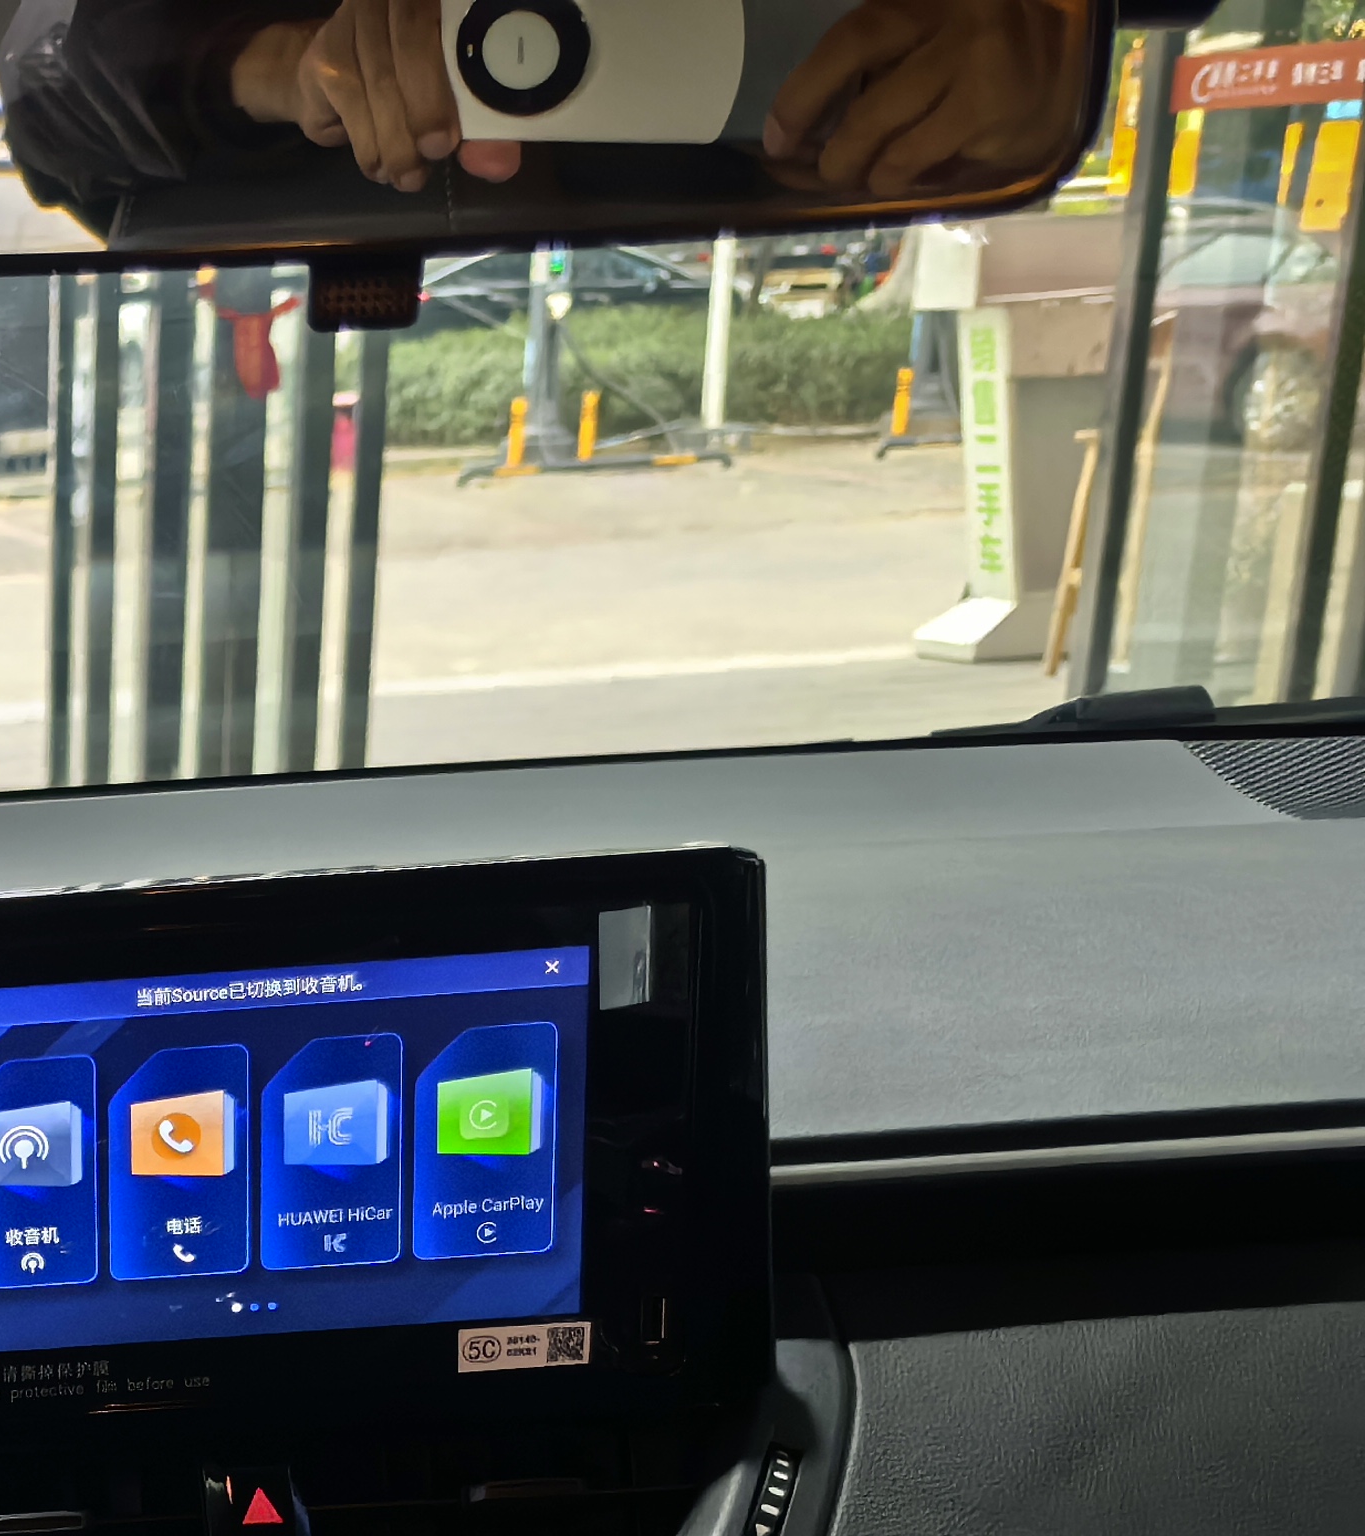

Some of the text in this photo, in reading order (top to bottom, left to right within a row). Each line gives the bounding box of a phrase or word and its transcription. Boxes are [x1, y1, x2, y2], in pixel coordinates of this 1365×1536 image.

[278, 1205, 393, 1227] HUAWEI HiCar
[432, 1195, 544, 1218] Apple CarPlay
[166, 1215, 203, 1235] 电话
[5, 1227, 59, 1246] 收音机
[469, 1339, 495, 1359] 5C
[10, 1382, 85, 1403] protective
[127, 1377, 174, 1392] before
[183, 1375, 210, 1388] use
